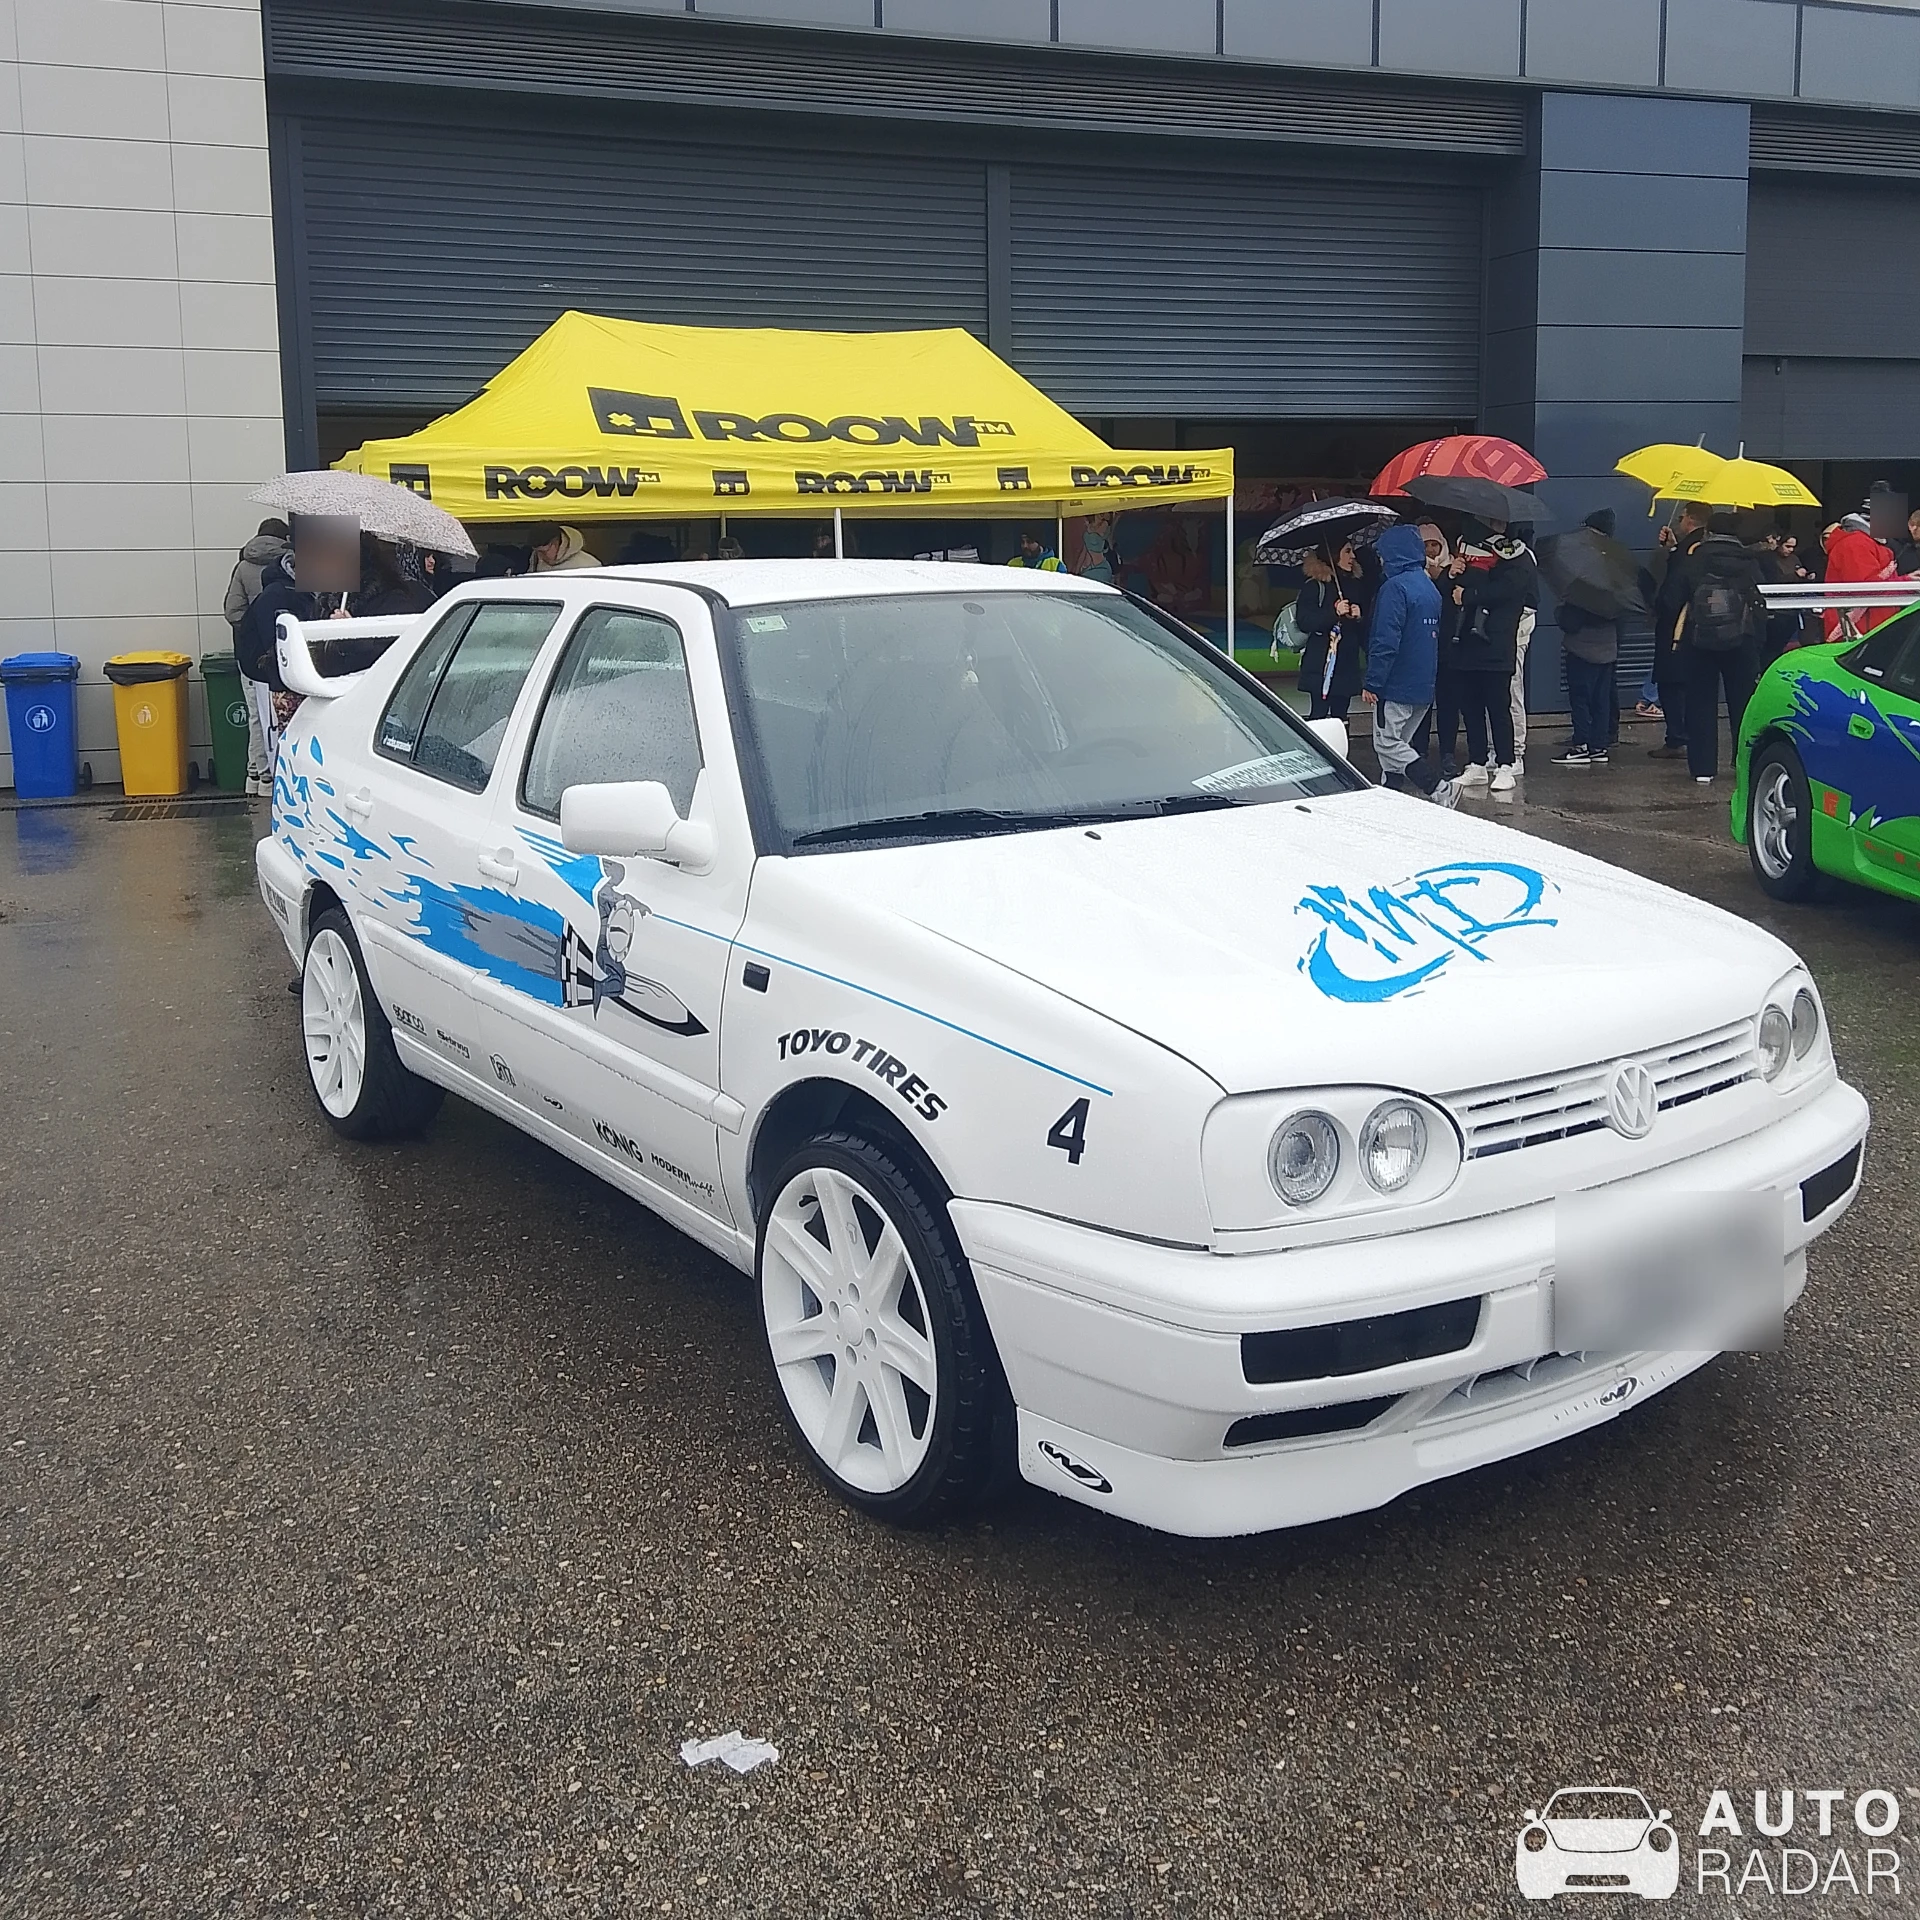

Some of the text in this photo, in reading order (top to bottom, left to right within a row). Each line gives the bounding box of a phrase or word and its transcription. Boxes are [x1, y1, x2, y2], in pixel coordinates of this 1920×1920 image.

[778, 1029, 947, 1121] TOYO TIRES
[592, 1117, 644, 1164] KÖNIG
[1046, 1096, 1091, 1166] 4
